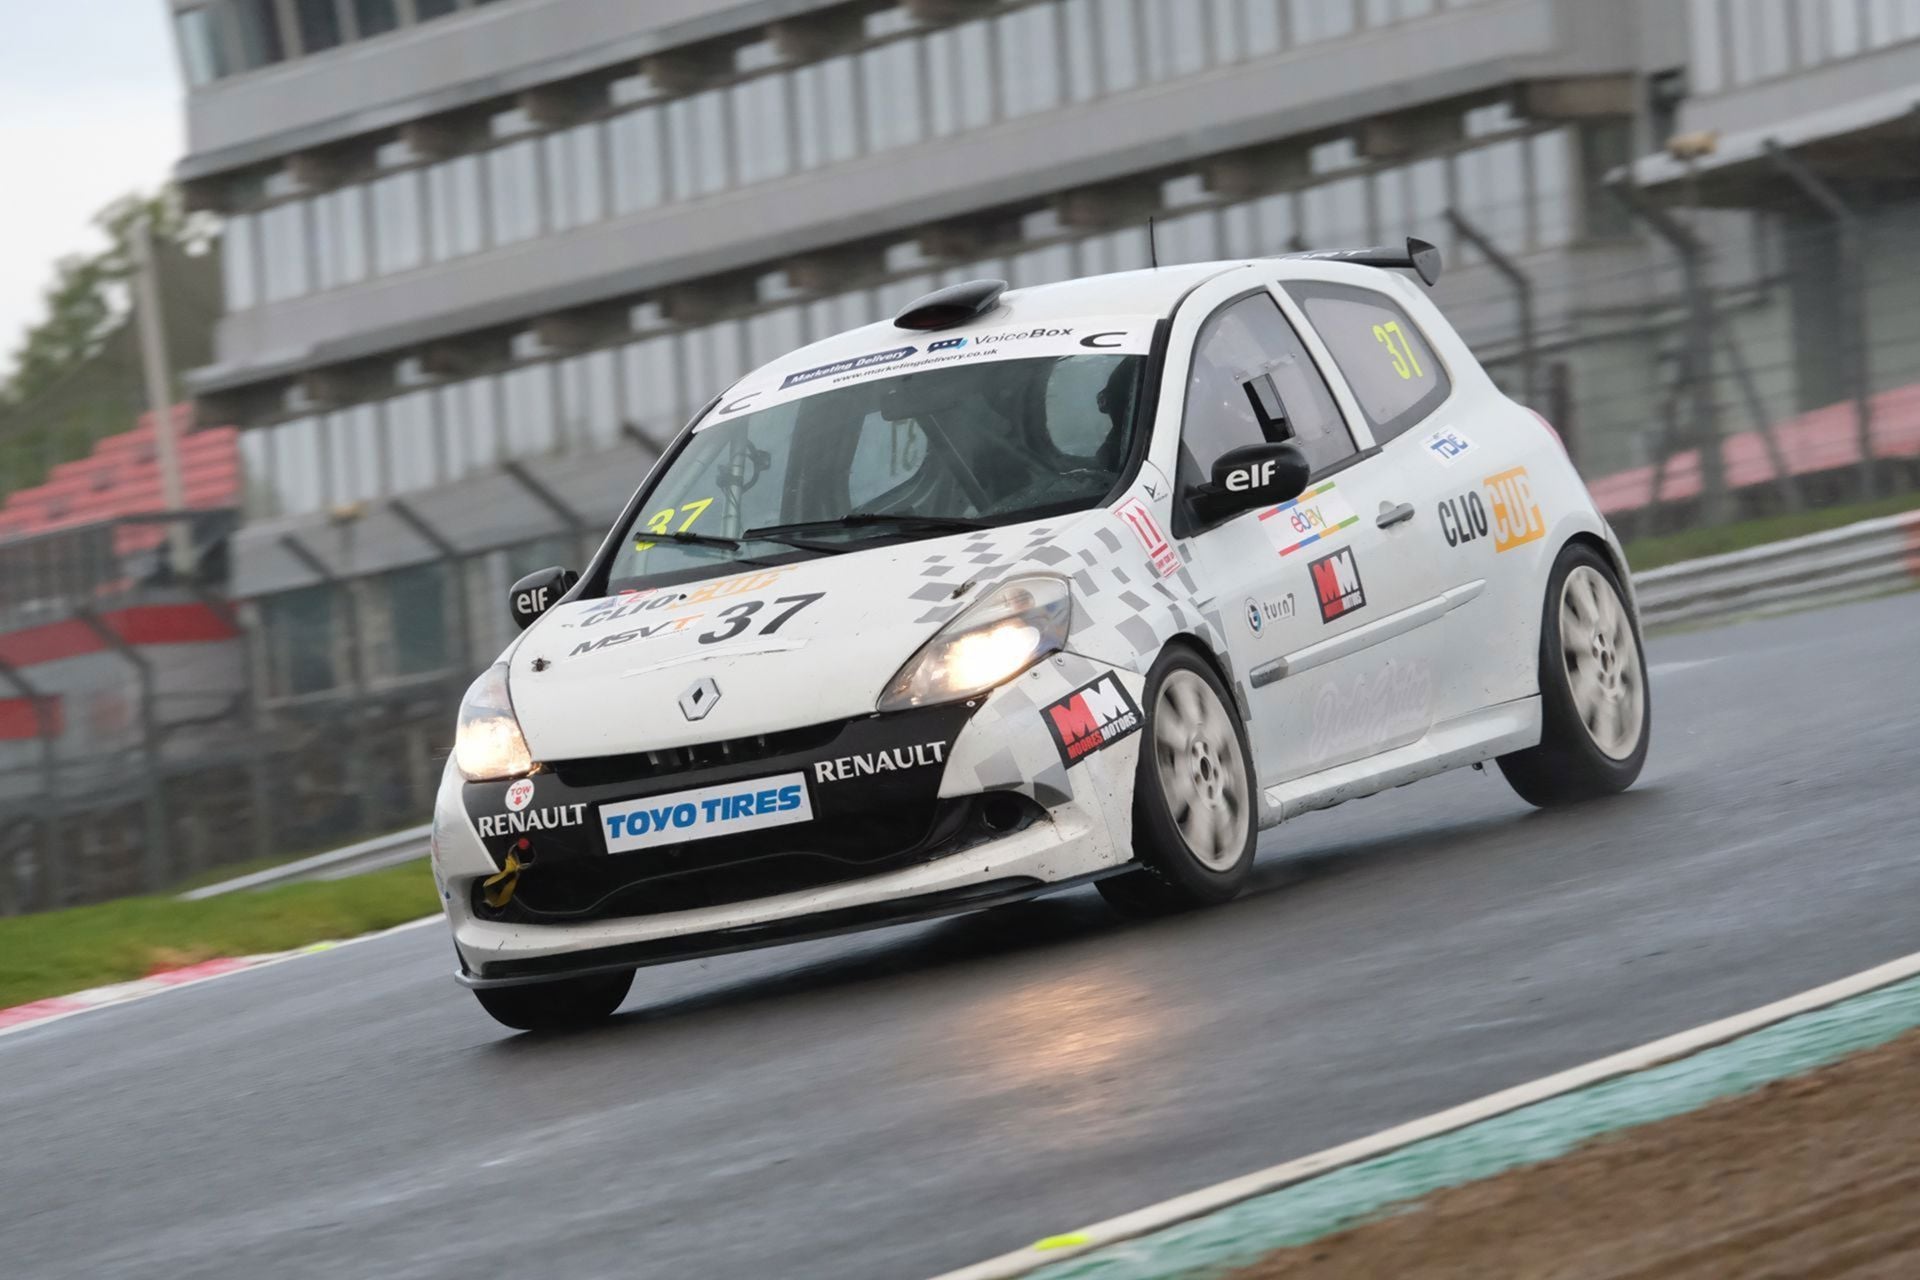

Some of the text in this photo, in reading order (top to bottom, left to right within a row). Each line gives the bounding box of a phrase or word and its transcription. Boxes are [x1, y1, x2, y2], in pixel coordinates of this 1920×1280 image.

[974, 328, 1074, 345] VoiceBox
[1080, 332, 1128, 348] C
[1372, 320, 1423, 380] 37
[790, 350, 907, 384] Marketing Delivery
[832, 349, 998, 383] www.marketingdelivery.co.uk
[1225, 460, 1276, 492] elf
[634, 497, 714, 552] 37
[1290, 505, 1328, 534] ebay
[1437, 469, 1542, 549] CLIO CUP
[516, 587, 548, 615] elf
[580, 593, 679, 627] CLIO
[1263, 593, 1296, 620] turn7
[569, 613, 704, 657] MSVT
[698, 591, 827, 645] 37
[1049, 677, 1131, 746] MM
[1067, 712, 1137, 759] MOORES MOTORS
[814, 740, 946, 783] RENAULT
[510, 785, 531, 796] TOW
[478, 803, 587, 838] RENAULT
[606, 785, 802, 839] TOYO TIRES
